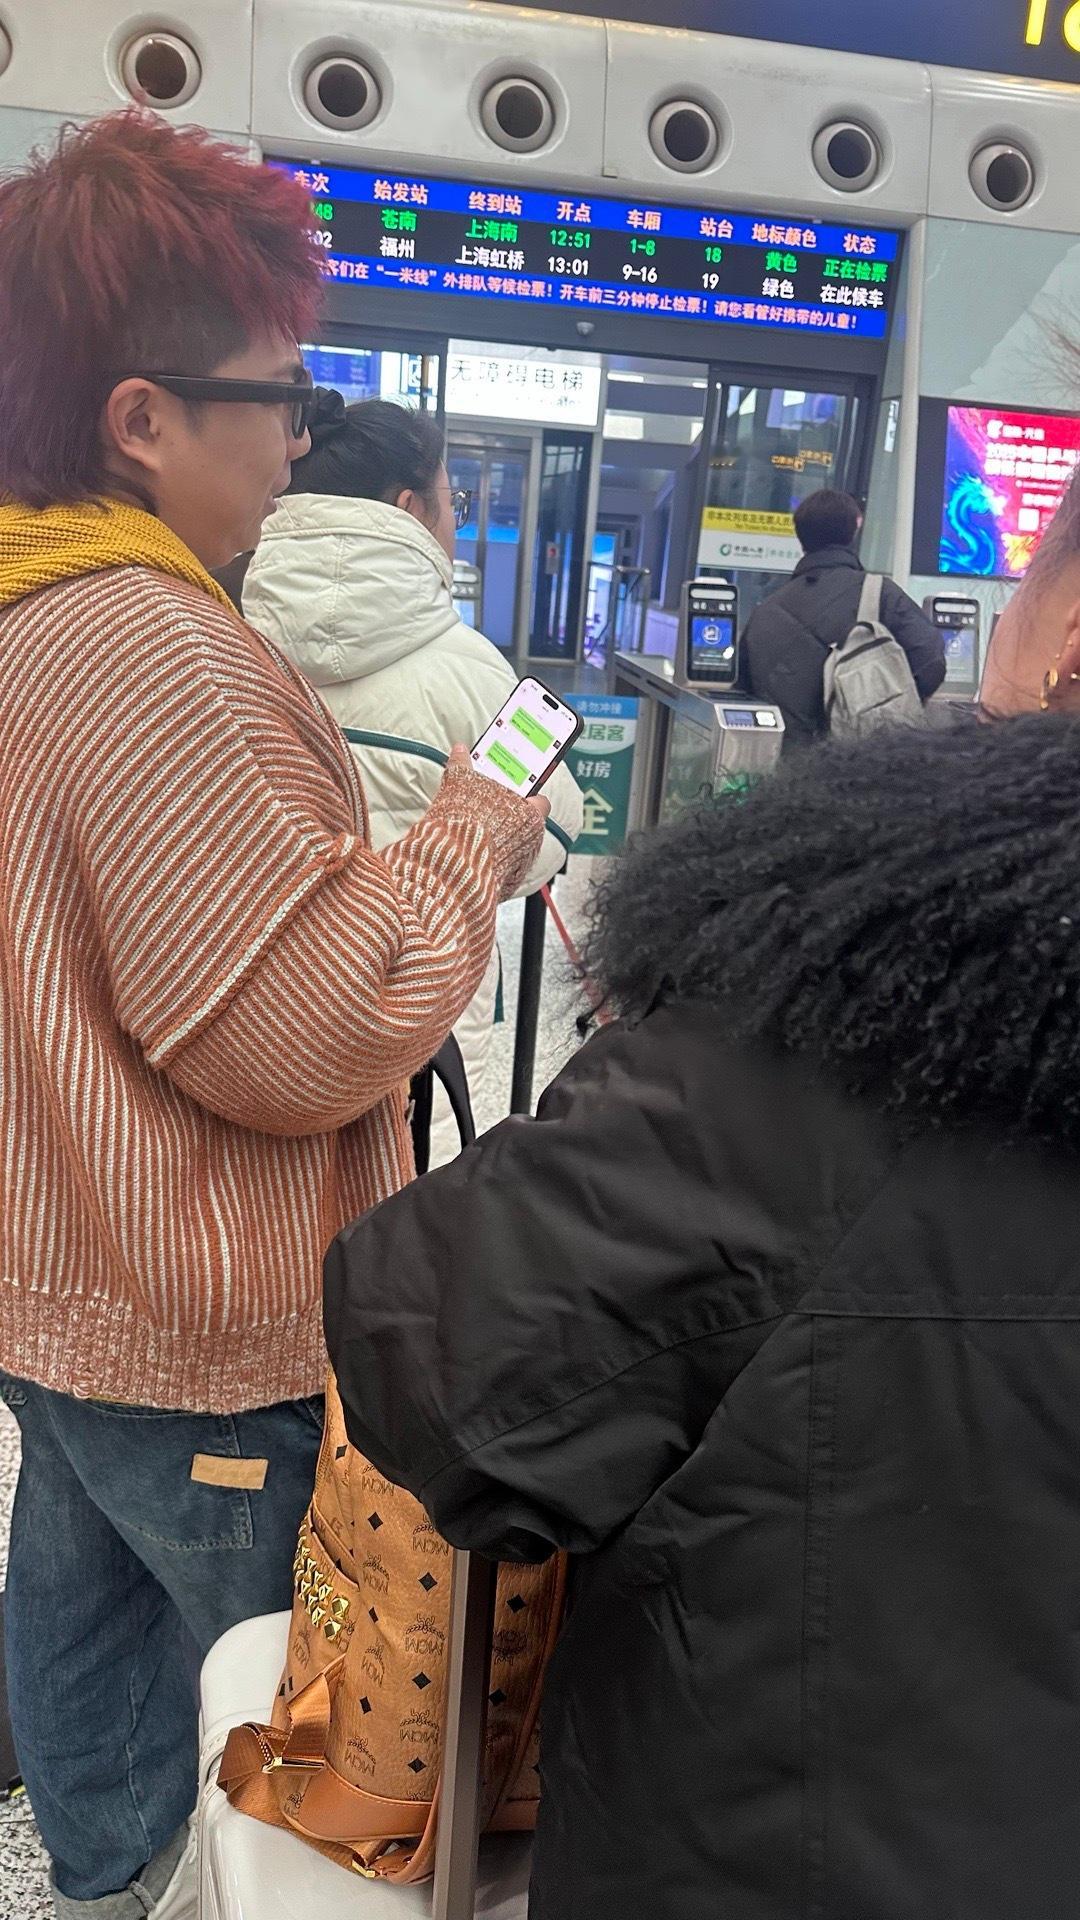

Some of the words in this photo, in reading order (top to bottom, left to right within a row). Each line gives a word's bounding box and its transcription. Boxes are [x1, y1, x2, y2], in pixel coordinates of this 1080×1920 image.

[294, 170, 330, 194] 车次
[373, 179, 429, 205] 始发站
[468, 191, 523, 216] 终到站
[556, 201, 592, 223] 开点
[626, 209, 662, 231] 车厢
[699, 217, 734, 240] 站台
[752, 223, 817, 248] 地标颜色
[843, 233, 877, 255] 状态
[381, 208, 418, 232] 苍南
[465, 218, 518, 244] 上海南
[549, 229, 591, 249] 12:51
[630, 238, 656, 257] 1-8
[704, 247, 722, 263] 18
[765, 251, 798, 274] 黄色
[822, 258, 889, 283] 正在检票
[379, 235, 415, 260] 福州
[455, 245, 525, 271] 上海虹桥
[547, 256, 589, 276] 13:01
[622, 264, 658, 284] 9-16
[701, 272, 720, 290] 19
[761, 277, 795, 300] 绿色
[820, 283, 884, 309] 在此候车
[576, 760, 612, 779] 好房
[582, 723, 625, 742] 居客
